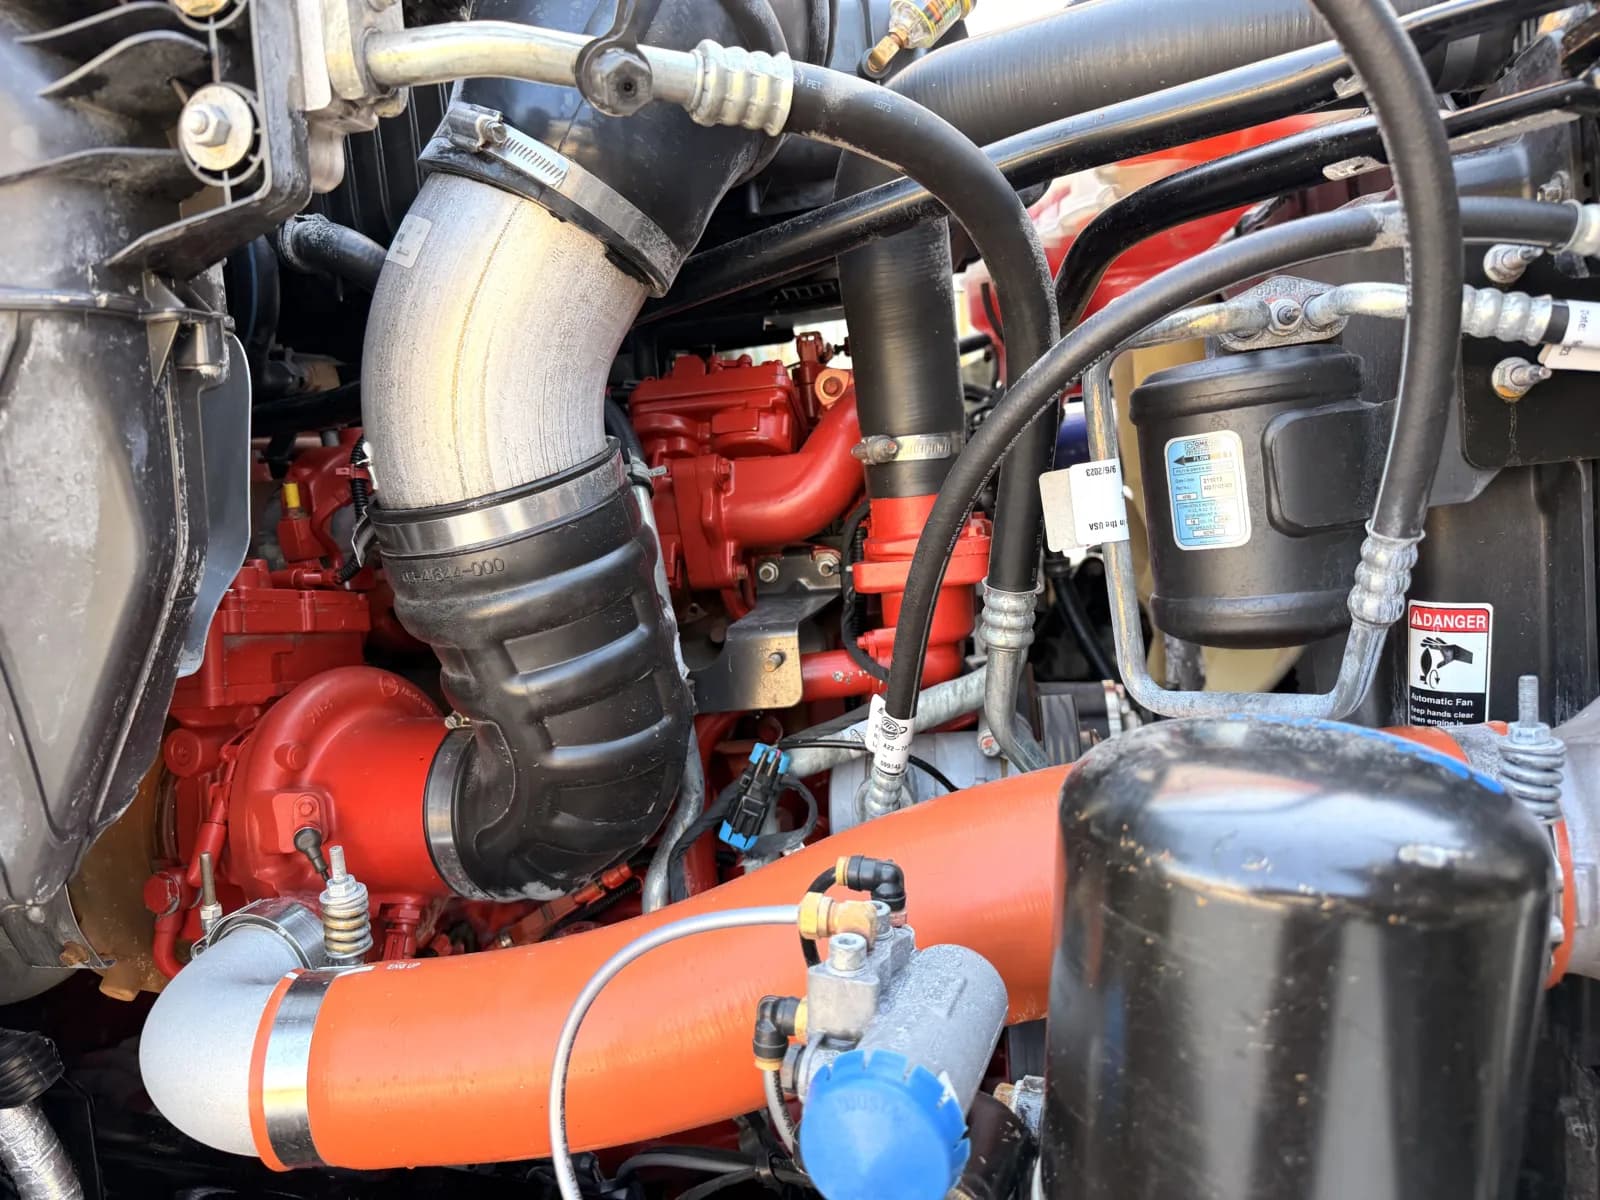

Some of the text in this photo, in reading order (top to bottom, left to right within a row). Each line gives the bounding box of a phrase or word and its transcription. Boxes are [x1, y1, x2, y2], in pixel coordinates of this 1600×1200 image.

[1085, 464, 1117, 477] 9/6/2023
[1088, 522, 1104, 531] USA
[1105, 520, 1118, 529] the
[1423, 613, 1486, 629] DANGER
[1411, 692, 1473, 707] Automatic Fan
[1426, 708, 1452, 718] hands
[1453, 711, 1474, 719] clear
[1427, 717, 1456, 727] engine
